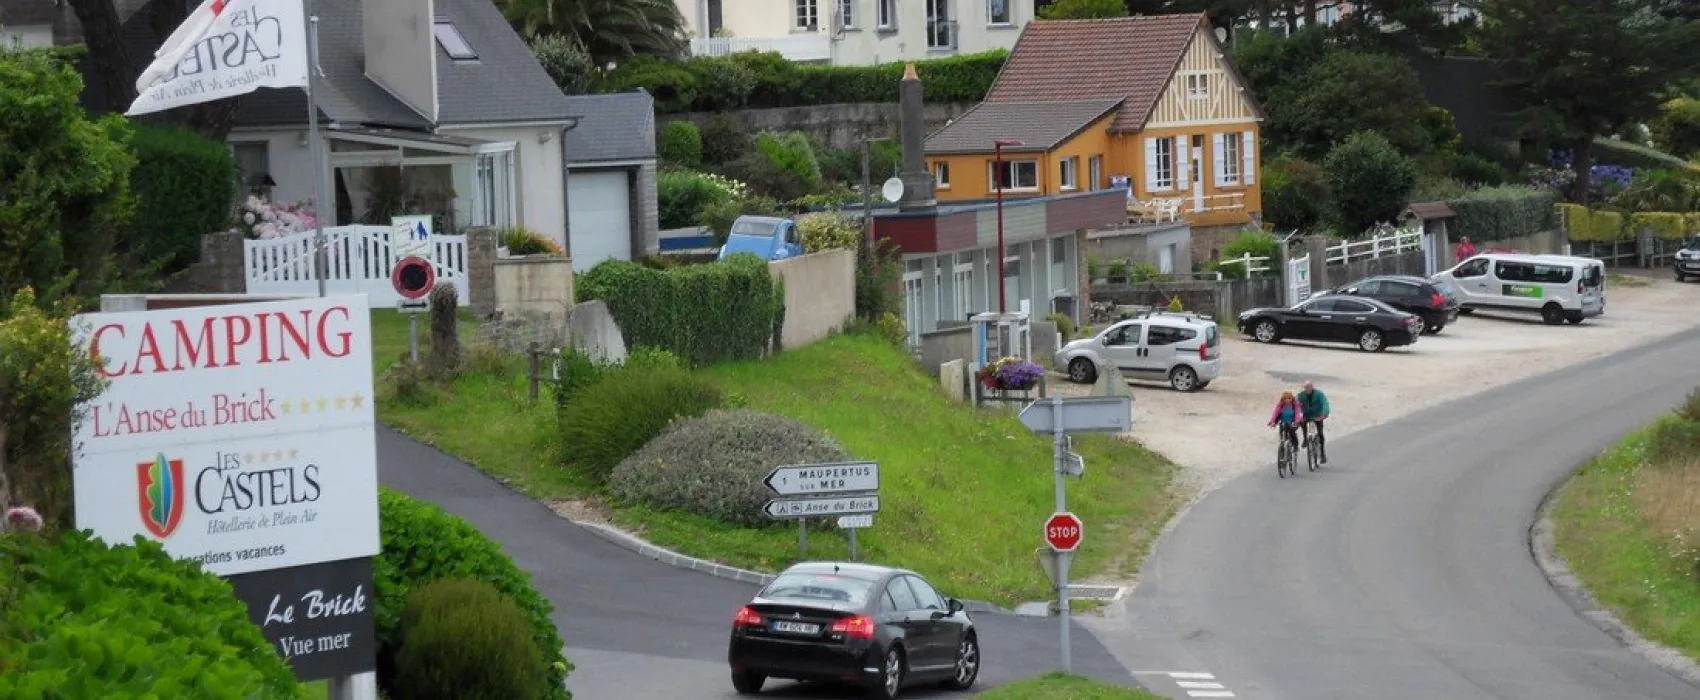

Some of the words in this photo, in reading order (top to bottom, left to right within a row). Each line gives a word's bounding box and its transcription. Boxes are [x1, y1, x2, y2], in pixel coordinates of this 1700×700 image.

[89, 306, 353, 378] CAMPING
[92, 402, 177, 438] L'Anse
[180, 402, 207, 429] du
[212, 388, 276, 427] Brick
[216, 451, 240, 471] LES
[798, 467, 871, 479] MAUPERTUS
[195, 464, 321, 515] CASTELS
[820, 480, 845, 489] MER
[804, 502, 829, 513] Anse
[833, 502, 845, 511] du
[849, 500, 874, 510] Brick
[207, 518, 255, 536] Hôtellerie
[258, 515, 269, 528] de
[272, 511, 298, 528] Plein
[300, 508, 318, 524] Air
[1050, 526, 1078, 539] STOP
[235, 543, 285, 560] vacances
[263, 593, 294, 627] Le
[301, 584, 366, 619] Brick
[280, 636, 314, 656] Vue
[317, 632, 351, 652] mer
